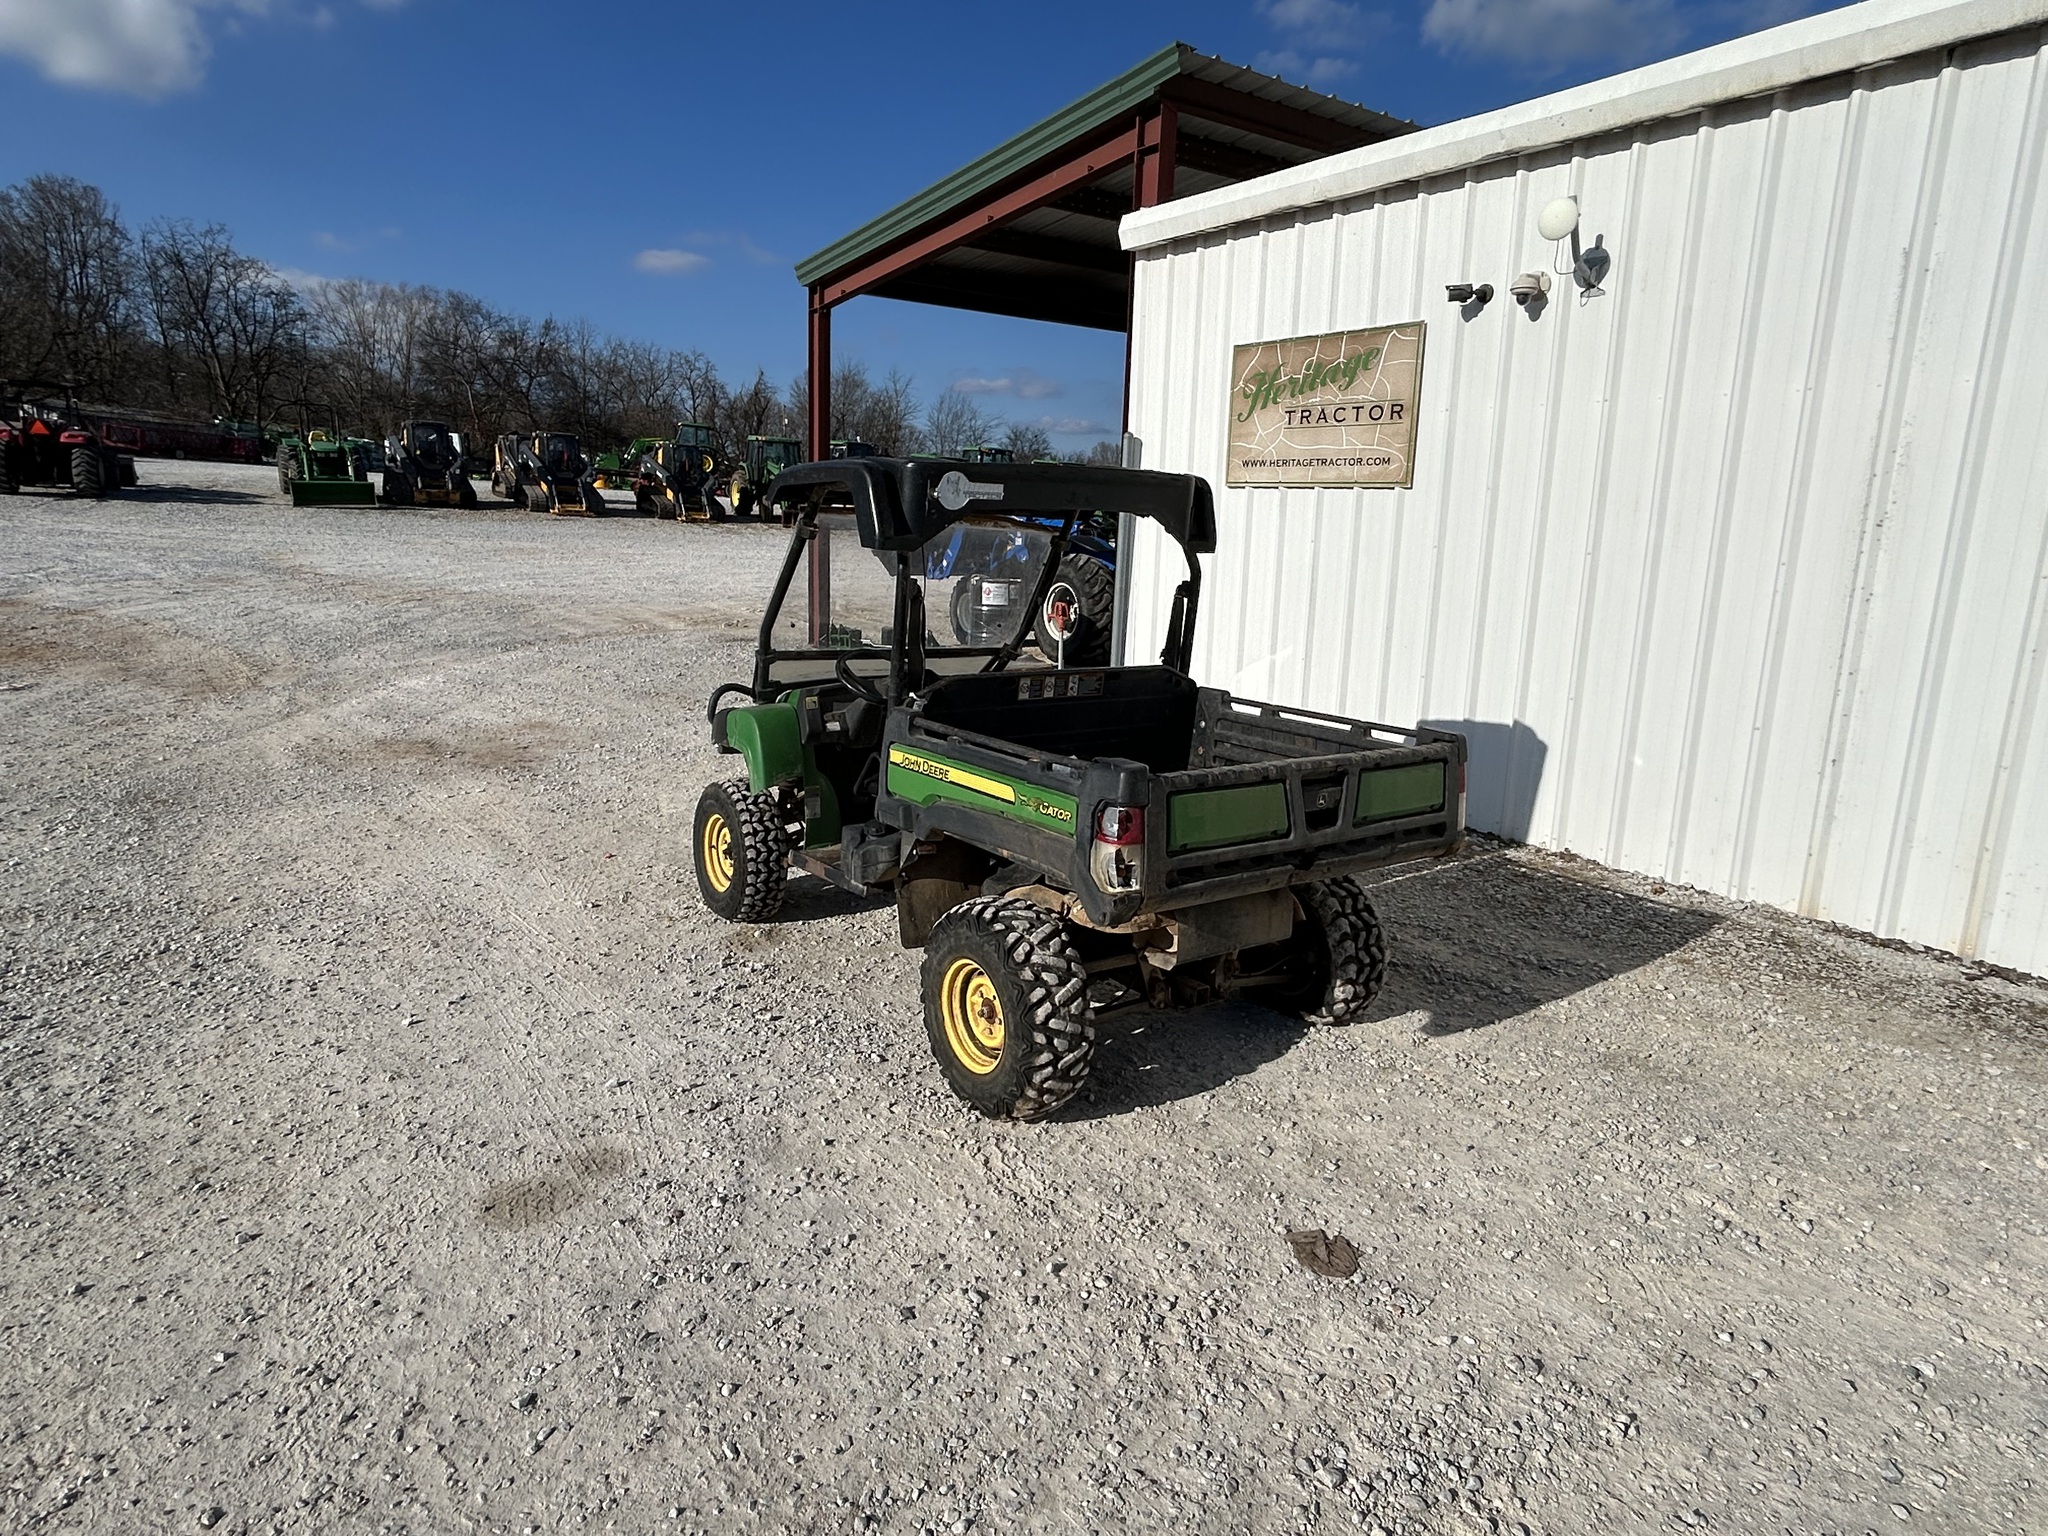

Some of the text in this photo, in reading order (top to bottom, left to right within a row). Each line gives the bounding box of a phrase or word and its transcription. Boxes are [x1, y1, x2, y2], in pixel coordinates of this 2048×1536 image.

[1238, 347, 1380, 423] Heritage
[1285, 403, 1404, 425] TRACTOR
[1241, 457, 1391, 468] WWW.HERITAGETRACTOR.COM
[899, 754, 950, 781] JOHN DEERE
[1039, 803, 1071, 821] GATOR
